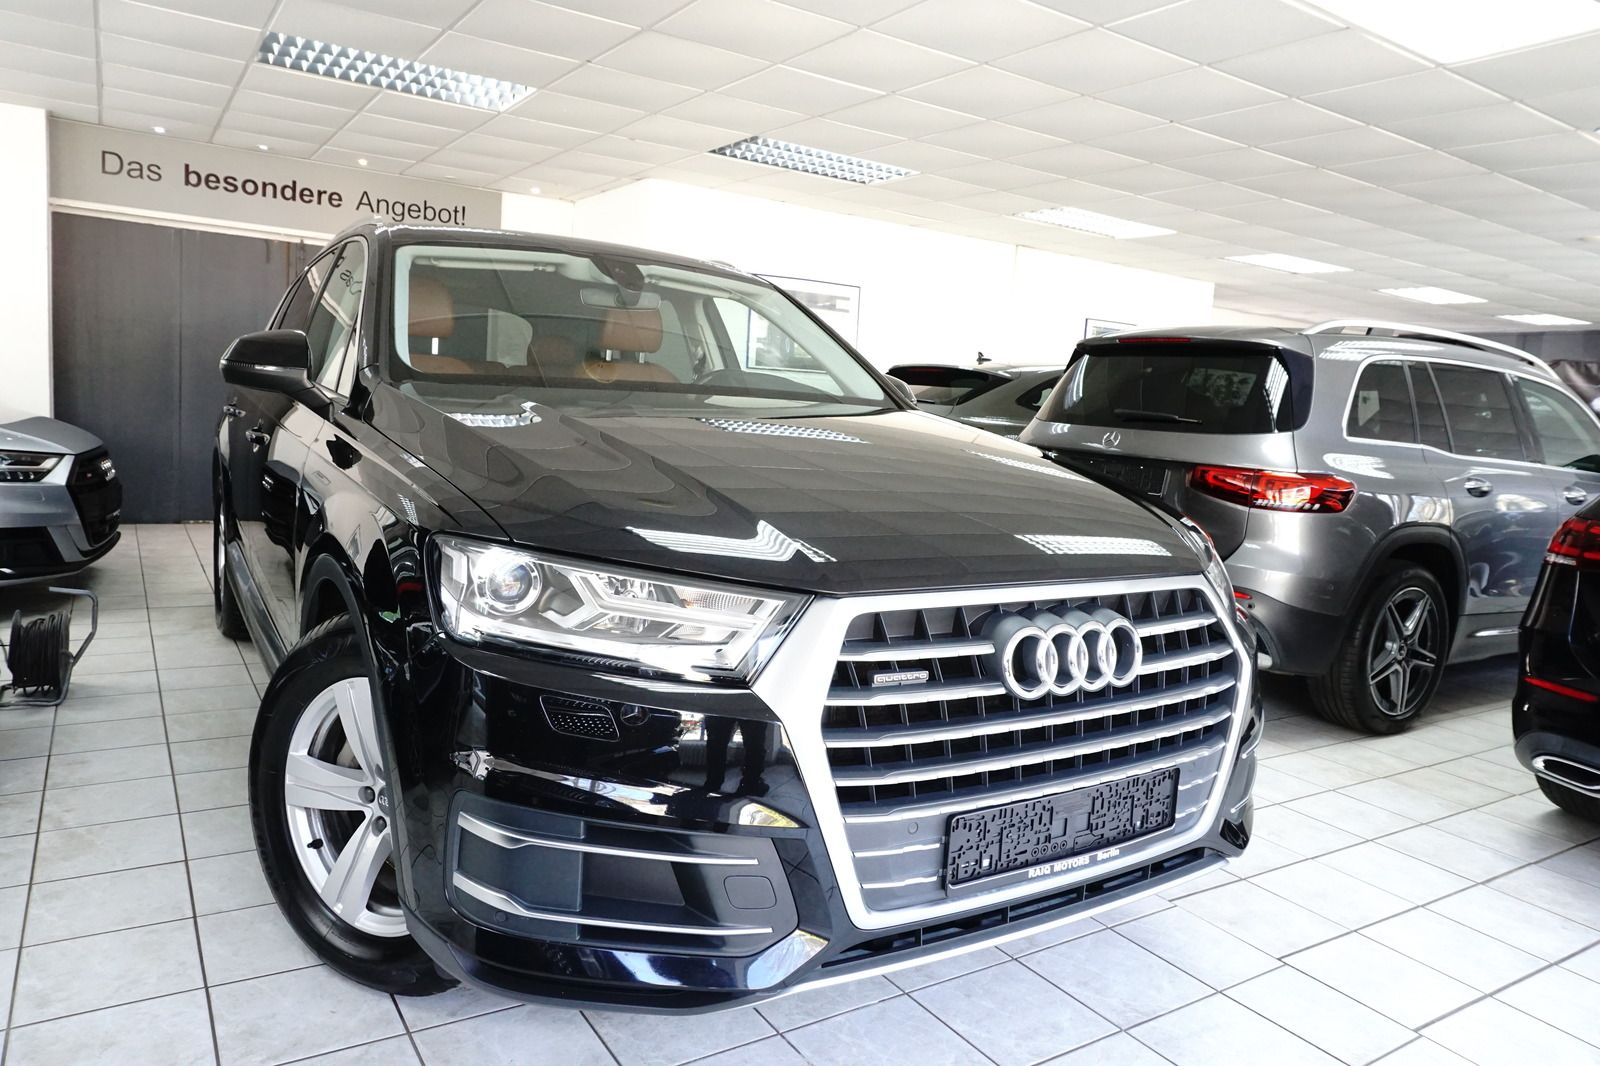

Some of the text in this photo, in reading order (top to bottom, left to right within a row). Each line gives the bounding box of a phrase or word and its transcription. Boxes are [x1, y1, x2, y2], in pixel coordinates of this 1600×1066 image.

[101, 151, 467, 226] Das besondere Angebot!
[876, 672, 927, 684] quattro
[1053, 856, 1090, 872] MOTORS
